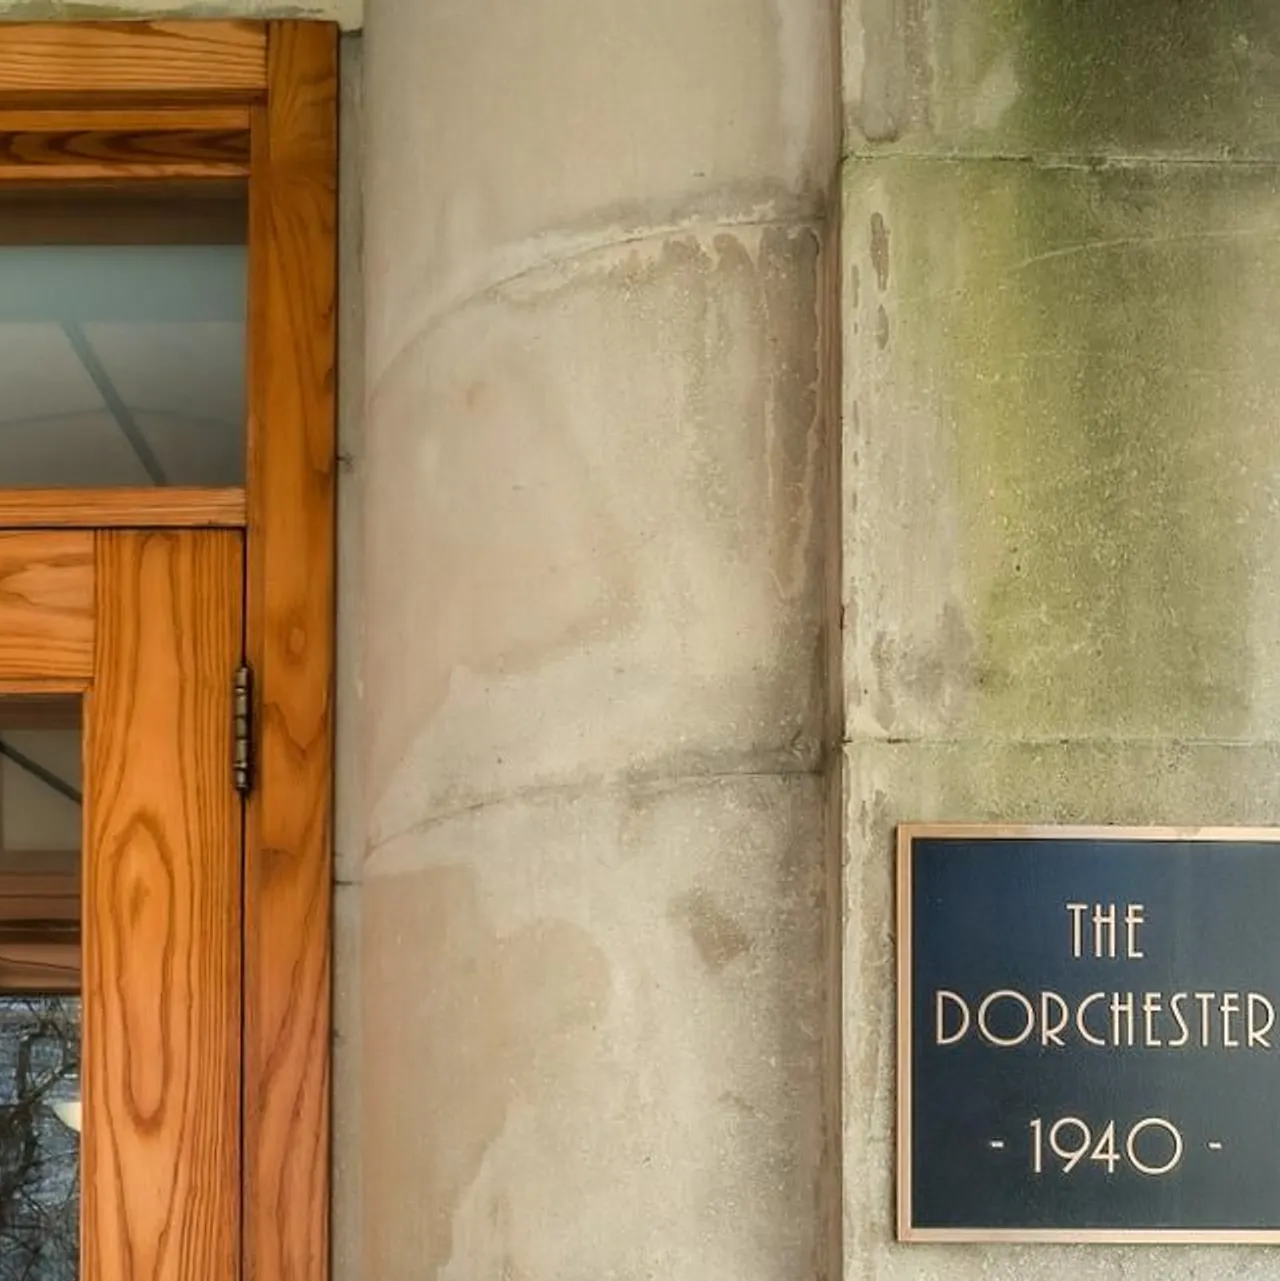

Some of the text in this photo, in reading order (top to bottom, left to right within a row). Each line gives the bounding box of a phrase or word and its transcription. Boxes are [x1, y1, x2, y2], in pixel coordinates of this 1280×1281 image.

[1066, 903, 1144, 958] THE
[935, 989, 1276, 1048] DORCHESTER
[1030, 1117, 1183, 1175] 1940
